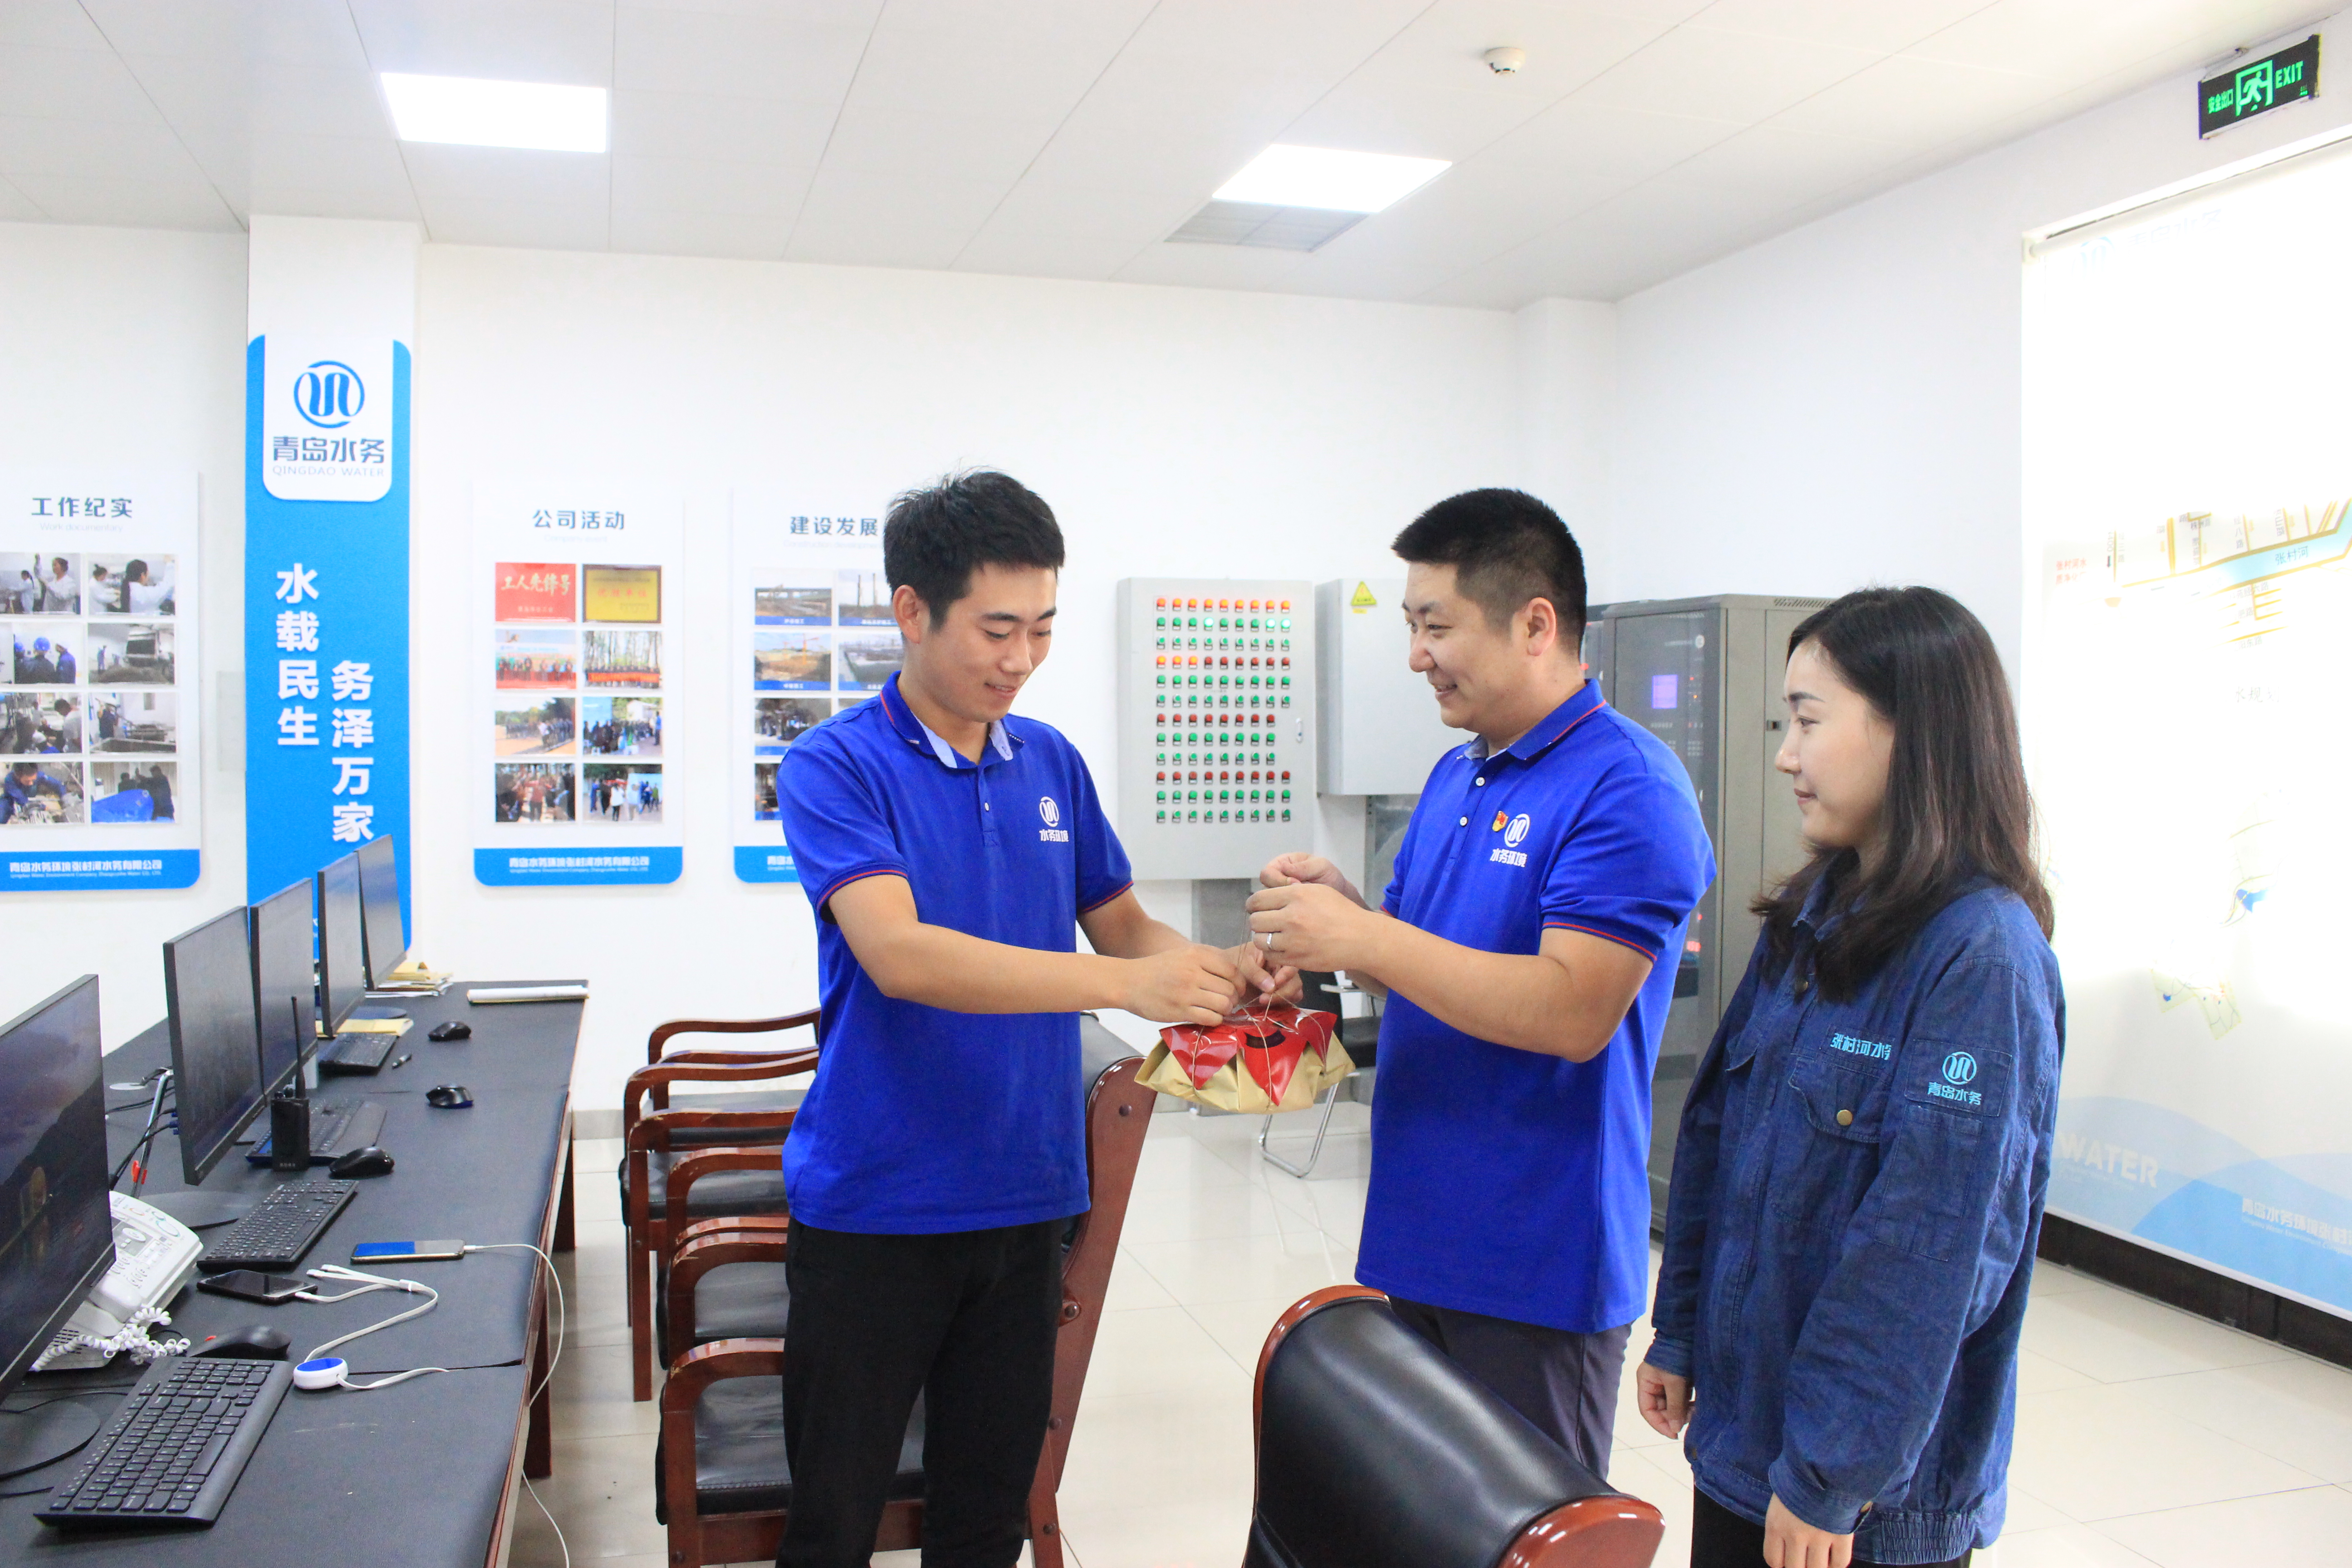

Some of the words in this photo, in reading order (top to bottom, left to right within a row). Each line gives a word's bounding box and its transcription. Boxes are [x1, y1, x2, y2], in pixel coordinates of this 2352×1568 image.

[2275, 60, 2304, 89] EXIT
[2208, 88, 2234, 114] 安全出口
[273, 436, 384, 463] 青岛水务
[272, 465, 336, 476] QINGDAO
[341, 467, 384, 477] WATER
[31, 496, 132, 519] 工作纪实
[532, 510, 625, 530] 公司活动
[790, 516, 878, 536] 建设发展
[2275, 545, 2309, 565] 张村河
[276, 563, 319, 745] 水载民生
[331, 660, 374, 843] 务泽万家
[1039, 828, 1069, 843] 水务环境
[1490, 848, 1528, 867] 水务环境
[1927, 1082, 1982, 1106] 青岛水务
[2058, 1131, 2159, 1188] WATER
